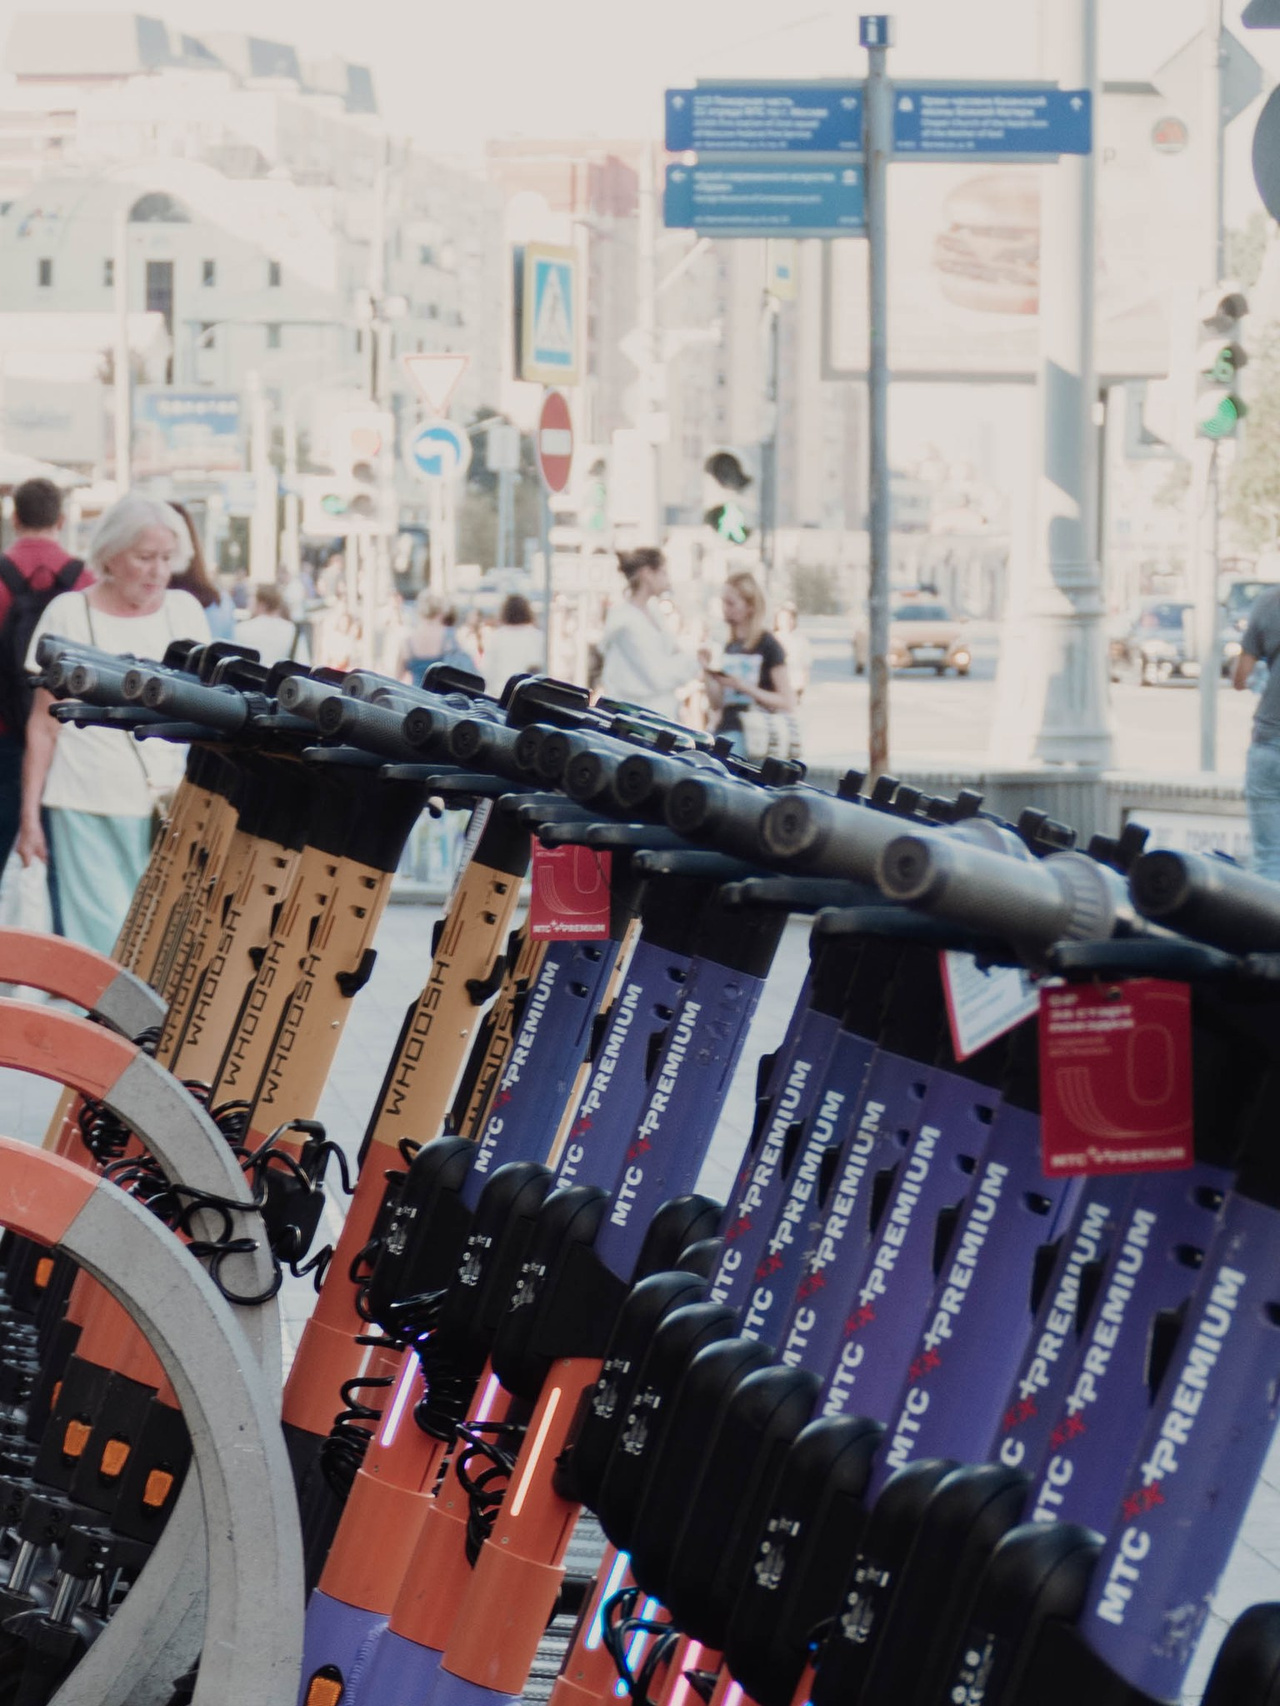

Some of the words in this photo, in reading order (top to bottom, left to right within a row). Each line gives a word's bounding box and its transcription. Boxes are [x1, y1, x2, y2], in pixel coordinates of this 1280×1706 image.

[186, 908, 244, 1047] WHOOSH
[223, 938, 287, 1086] WHOOSH
[261, 952, 322, 1105] WHOOSH
[385, 960, 450, 1116] WHOOSH
